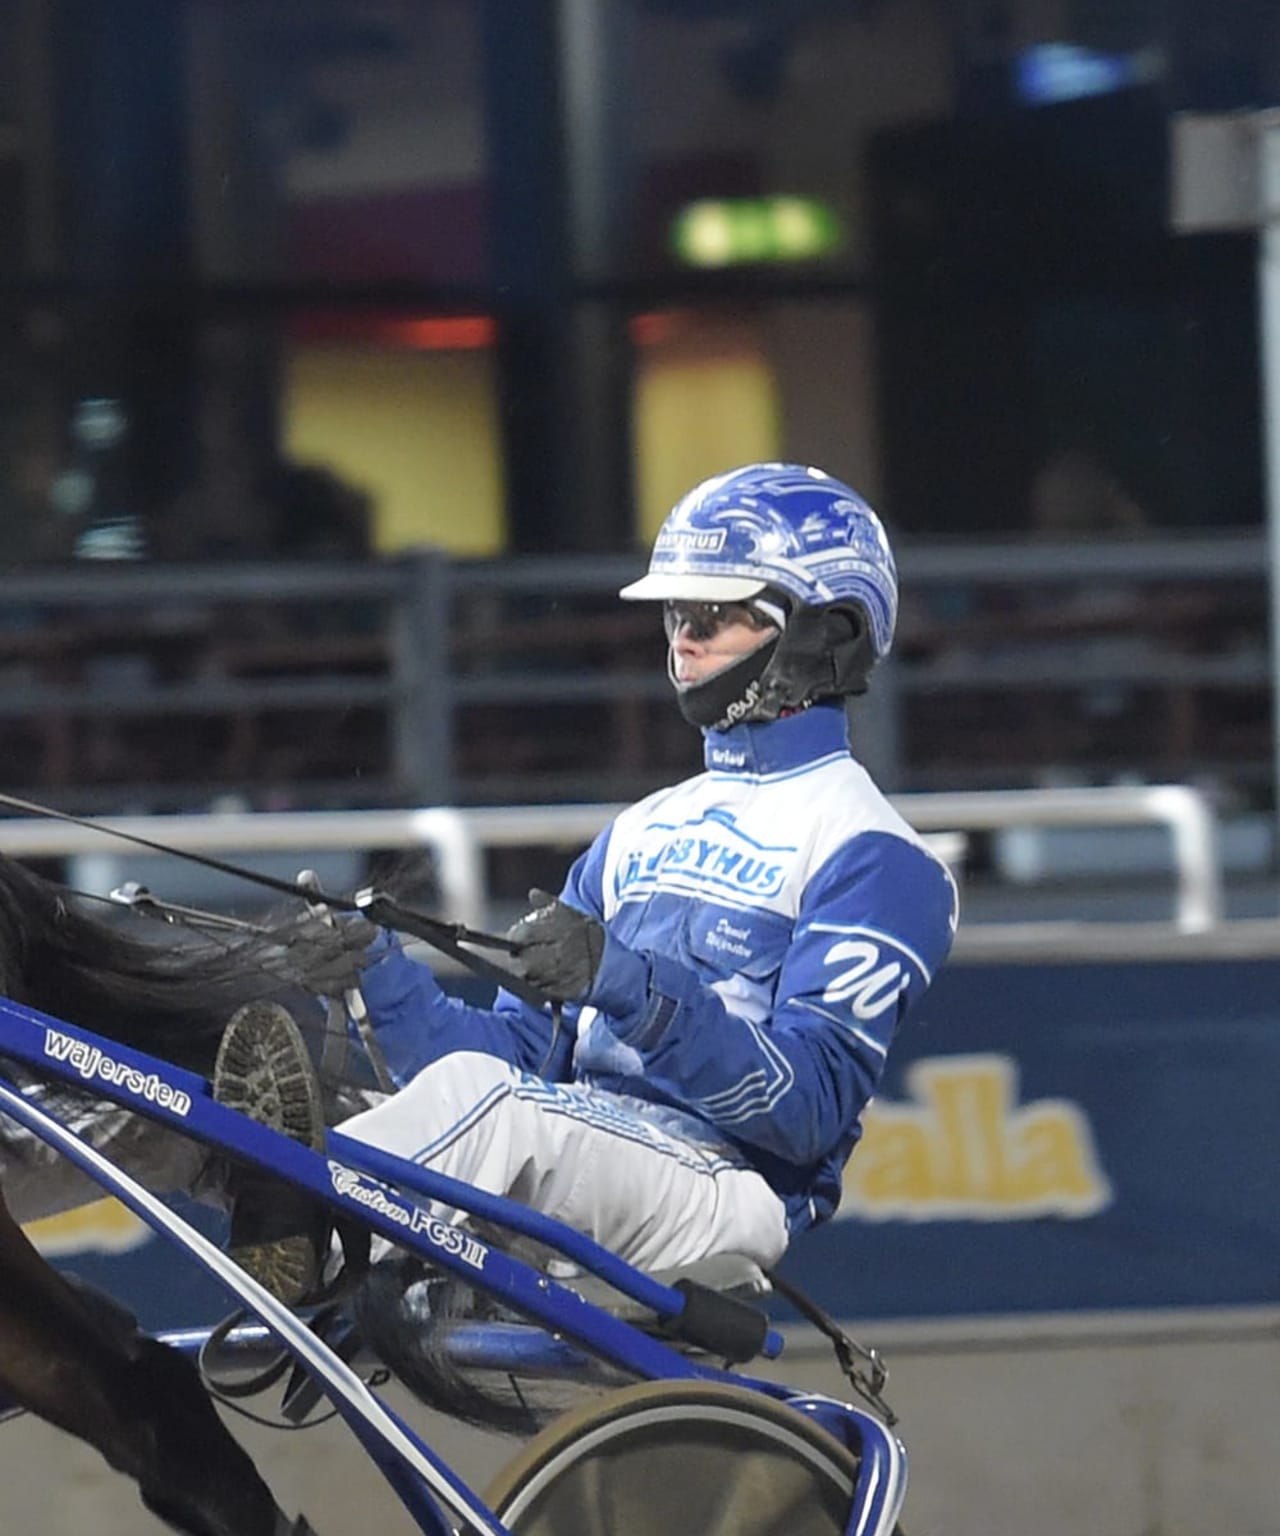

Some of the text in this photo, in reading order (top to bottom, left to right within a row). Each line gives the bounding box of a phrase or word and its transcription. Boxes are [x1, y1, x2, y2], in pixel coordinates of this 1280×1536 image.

[836, 1055, 1108, 1219] alla
[328, 1160, 410, 1225] Custom
[410, 1207, 463, 1254] FCS
